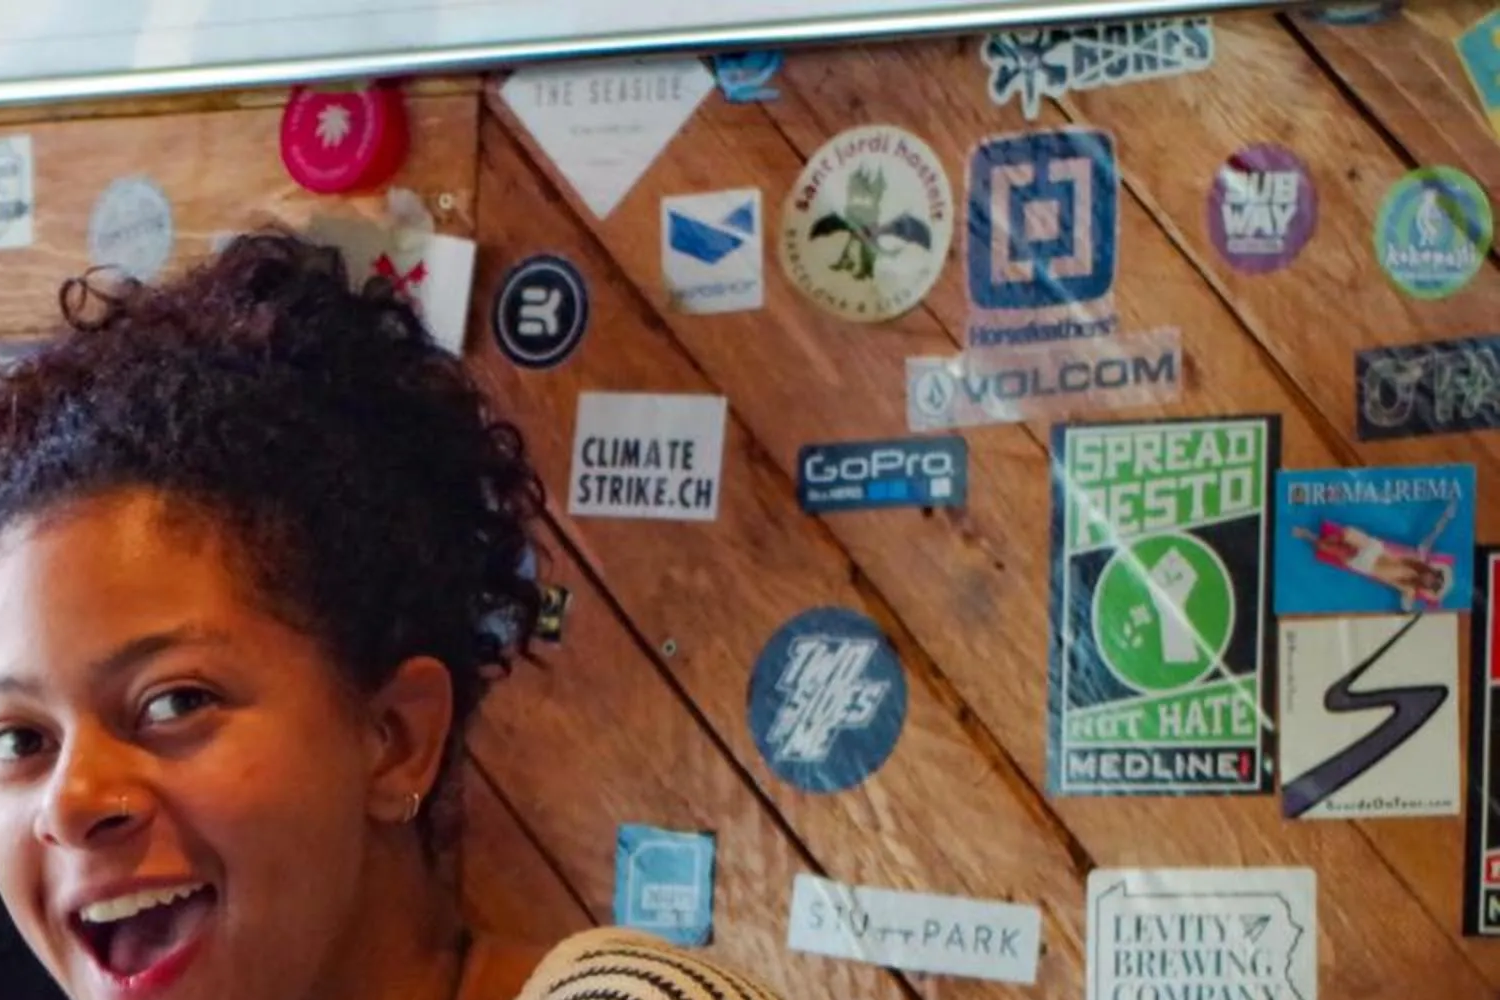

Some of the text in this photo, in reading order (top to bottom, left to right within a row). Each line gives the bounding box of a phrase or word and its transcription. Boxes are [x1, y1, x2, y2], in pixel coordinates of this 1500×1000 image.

[535, 75, 684, 109] THE SEASIDE
[1221, 169, 1299, 203] SUB
[1221, 203, 1297, 238] WAY
[961, 353, 1177, 402] VOLCOM
[581, 438, 695, 471] CLIMATE
[804, 449, 948, 482] GoPro
[1075, 429, 1255, 480] SPREAD
[577, 477, 714, 508] STRIKE.CH
[1073, 469, 1253, 547] PESTO
[1070, 691, 1255, 741] NOT HATE
[1113, 912, 1228, 945] LEVITY
[1113, 947, 1274, 979] BREWING
